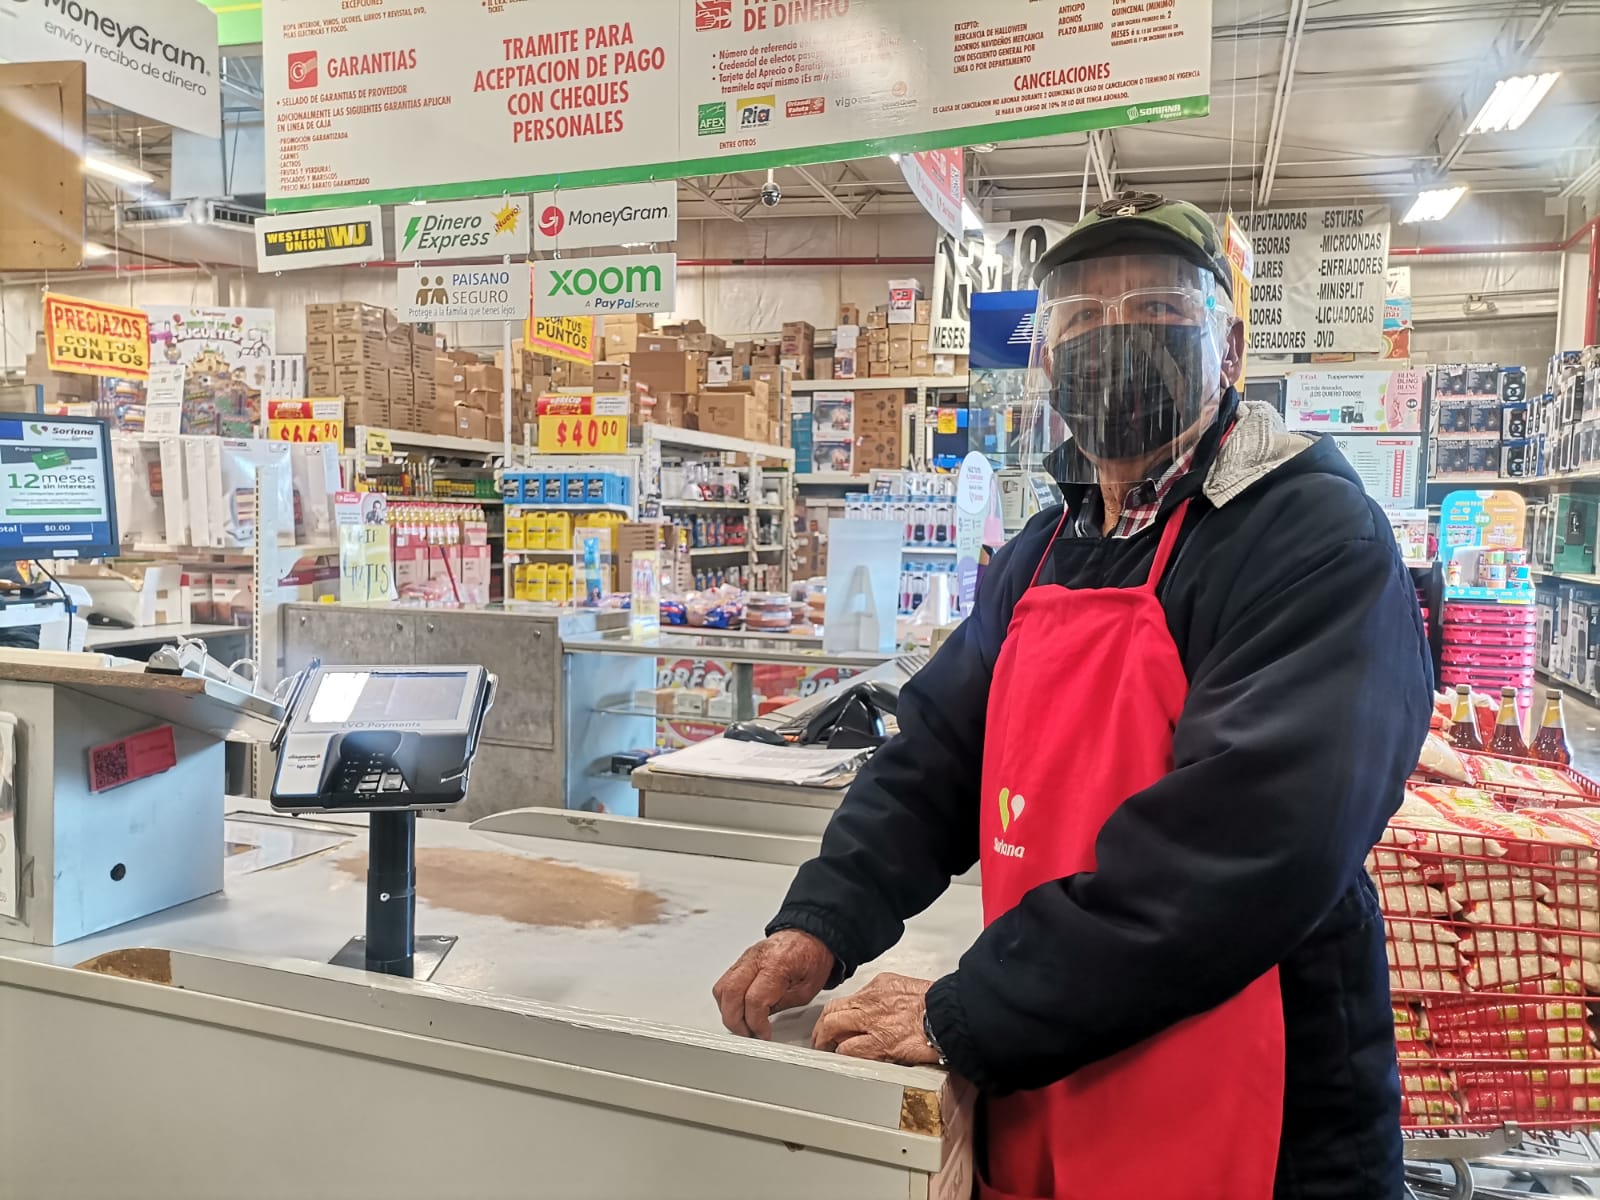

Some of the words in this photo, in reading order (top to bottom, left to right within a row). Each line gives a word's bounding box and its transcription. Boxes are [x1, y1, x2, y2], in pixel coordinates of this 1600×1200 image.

[743, 6, 767, 32] DE
[774, 0, 850, 28] DINERO
[1058, 2, 1086, 14] ANTICIPO
[1111, 5, 1144, 17] QUINCENAL
[1145, 0, 1176, 12] (MINIMO)
[954, 21, 979, 31] EXCEPTO:
[1058, 14, 1083, 25] ABONOS
[43, 0, 206, 74] MoneyGram
[954, 30, 985, 42] MERCANCIA
[986, 29, 993, 37] DE
[994, 23, 1028, 35] HALLOWEEN
[1057, 26, 1077, 37] PLAZO
[1078, 21, 1104, 34] MAXIMO
[1110, 28, 1129, 39] MESES
[503, 30, 579, 61] TRAMITE
[585, 22, 634, 50] PARA
[954, 41, 980, 52] ADORNOS
[981, 35, 1012, 48] NAVIDEÑOS
[1012, 31, 1044, 43] MERCANCIA
[44, 20, 82, 46] envío
[84, 39, 93, 54] y
[94, 43, 139, 71] recibo
[141, 62, 160, 79] de
[162, 70, 207, 97] dinero
[719, 48, 748, 60] Número
[749, 46, 759, 55] de
[760, 42, 798, 54] referencia
[953, 55, 966, 63] CON
[966, 49, 997, 61] DESCUENTO
[998, 46, 1023, 57] GENERAL
[1023, 43, 1036, 53] POR
[327, 48, 417, 78] GARANTIAS
[473, 57, 580, 93] ACEPTACION
[586, 54, 608, 79] DE
[614, 46, 665, 75] PAGO
[719, 57, 757, 71] Credencial
[758, 55, 768, 66] de
[953, 65, 969, 74] LINEA
[975, 62, 987, 71] POR
[988, 55, 1032, 69] DEPARTAMENTO
[719, 72, 744, 84] Tarjeta
[745, 69, 757, 79] del
[759, 66, 786, 80] Aprecio
[756, 78, 773, 91] aquí
[775, 76, 799, 88] mismo
[1013, 62, 1111, 92] CANCELACIONES
[282, 95, 308, 106] SELLADO
[310, 94, 318, 103] DE
[320, 90, 357, 102] GARANTIAS
[358, 89, 367, 98] DE
[368, 85, 407, 97] PROVEEDOR
[507, 91, 544, 115] CON
[550, 80, 630, 110] CHEQUES
[939, 104, 954, 113] CAUSA
[961, 100, 991, 110] CANCELACION
[1000, 95, 1020, 105] ABONAR
[1021, 93, 1043, 102] DURANTE
[1048, 88, 1075, 98] QUINCENAS
[1084, 84, 1097, 93] CASO
[1104, 79, 1138, 90] CANCELACION
[1144, 74, 1168, 84] TERMINO
[1169, 73, 1175, 81] DE
[1176, 70, 1200, 80] VIGENCIA
[277, 108, 331, 122] ADICIONALMENTE
[333, 107, 344, 117] LAS
[346, 103, 382, 115] SIGUIENTES
[383, 98, 421, 111] GARANTIAS
[423, 95, 451, 107] APLICAN
[835, 97, 858, 108] vigo
[1023, 105, 1040, 113] CARGO
[1086, 96, 1102, 104] TENGA
[1103, 92, 1129, 102] ABONADO.
[699, 118, 725, 129] AFEX
[741, 106, 770, 124] Ria
[287, 121, 305, 131] LINEA
[306, 121, 314, 129] DE
[316, 119, 331, 128] CAJA
[513, 109, 624, 143] PERSONALES
[720, 140, 736, 150] ENTRE
[737, 138, 757, 148] OTROS
[334, 177, 370, 187] GARANTIZADO
[423, 214, 482, 232] Dinero
[494, 204, 521, 233] ¡Nuevo!
[568, 205, 668, 227] MoneyGram
[1238, 212, 1308, 232] COMPUTADORAS
[266, 227, 325, 244] WESTERN
[330, 223, 367, 247] WU
[417, 232, 490, 254] Express
[285, 238, 325, 252] UNION
[1252, 236, 1291, 255] RESORAS
[452, 271, 510, 286] PAISANO
[1252, 260, 1284, 279] ULARES
[547, 265, 661, 296] xoom
[452, 289, 508, 304] SEGURO
[1250, 284, 1283, 302] ADORAS
[408, 307, 433, 318] Protege
[438, 307, 445, 316] la
[446, 306, 467, 316] familia
[469, 308, 480, 318] que
[482, 305, 500, 316] tienes
[501, 305, 516, 317] lejos
[594, 298, 635, 310] PayPal
[635, 300, 660, 308] Service
[54, 305, 142, 341] PRECIAZOS
[565, 317, 582, 334] TUS
[1248, 308, 1282, 326] ADORAS
[64, 335, 99, 348] CON
[106, 340, 136, 354] TUS
[536, 321, 588, 350] PUNTOS
[934, 326, 966, 350] MESES
[1248, 331, 1306, 349] IGERADORES
[57, 345, 143, 367] PUNTOS
[52, 427, 94, 436] Soriana
[557, 419, 598, 447] $40
[602, 420, 618, 437] 00
[8, 473, 41, 489] 12
[41, 473, 96, 484] meses
[0, 524, 17, 533] otal
[44, 524, 71, 532] $0.00
[367, 721, 421, 729] Payments
